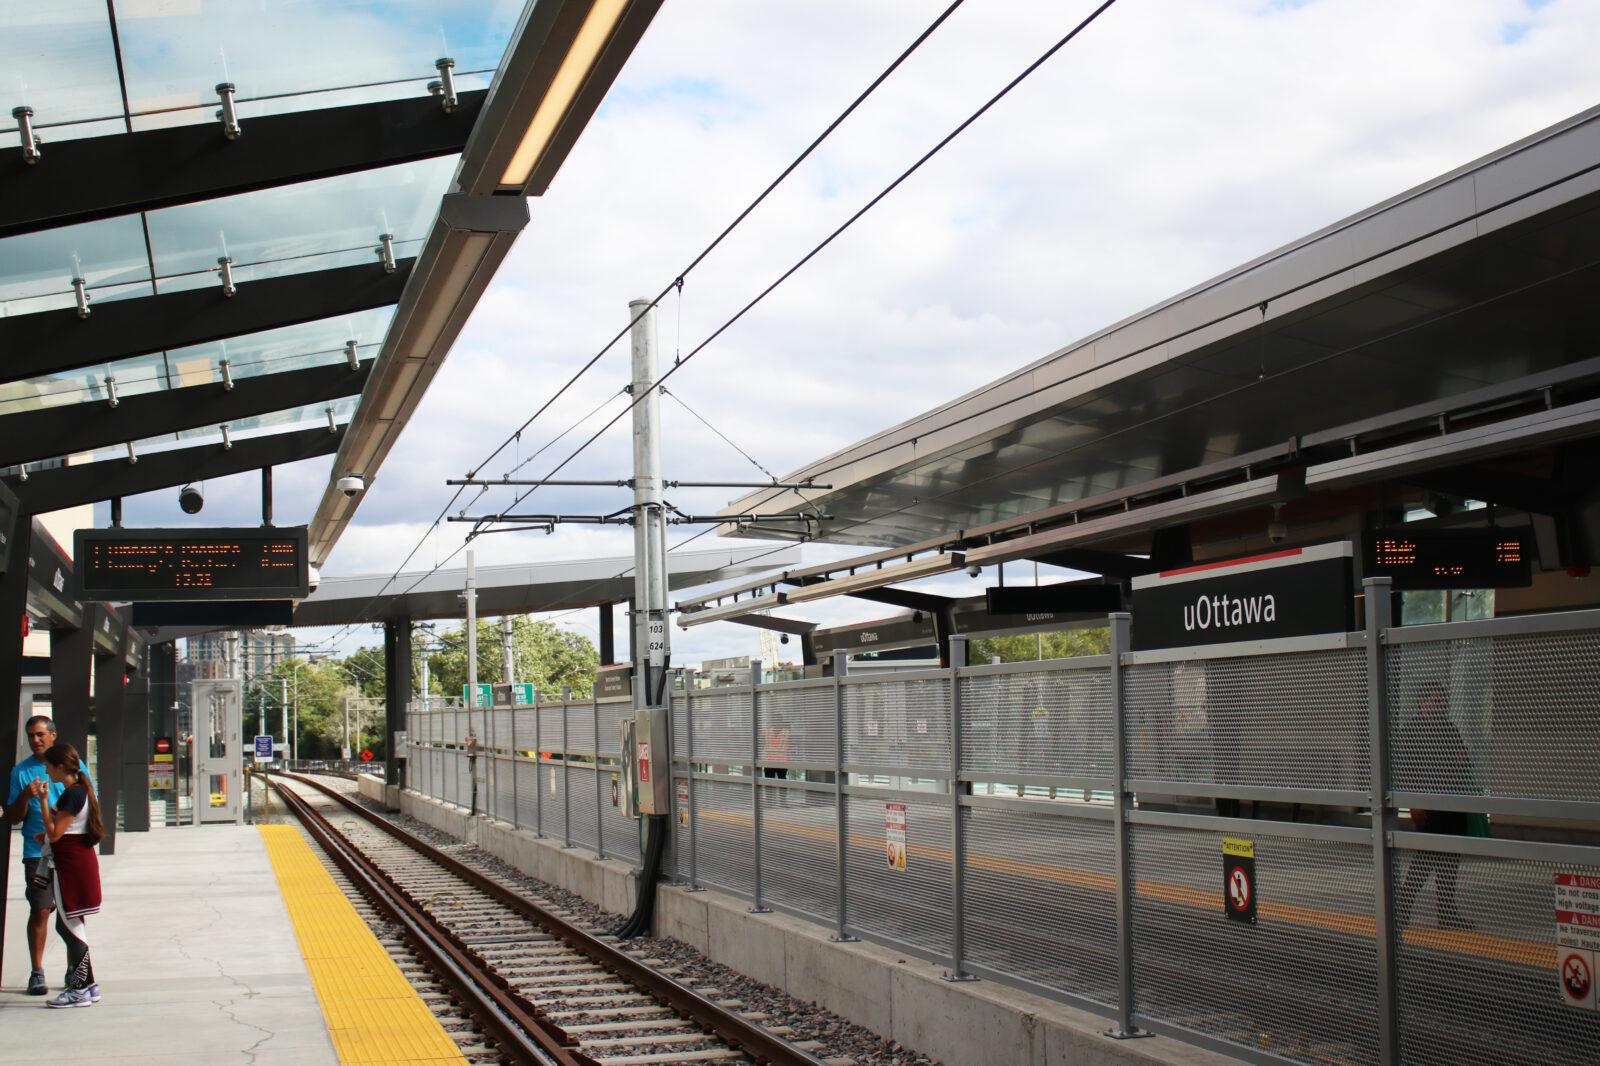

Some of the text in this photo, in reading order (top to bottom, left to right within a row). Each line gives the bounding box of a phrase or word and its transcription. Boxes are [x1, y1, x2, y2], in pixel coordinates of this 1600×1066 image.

[1184, 594, 1276, 631] uOttawa
[649, 625, 663, 634] 103
[649, 641, 664, 650] 624
[1557, 887, 1599, 900] Do not cross
[1558, 898, 1599, 913] High voltage
[1581, 915, 1600, 926] DAN
